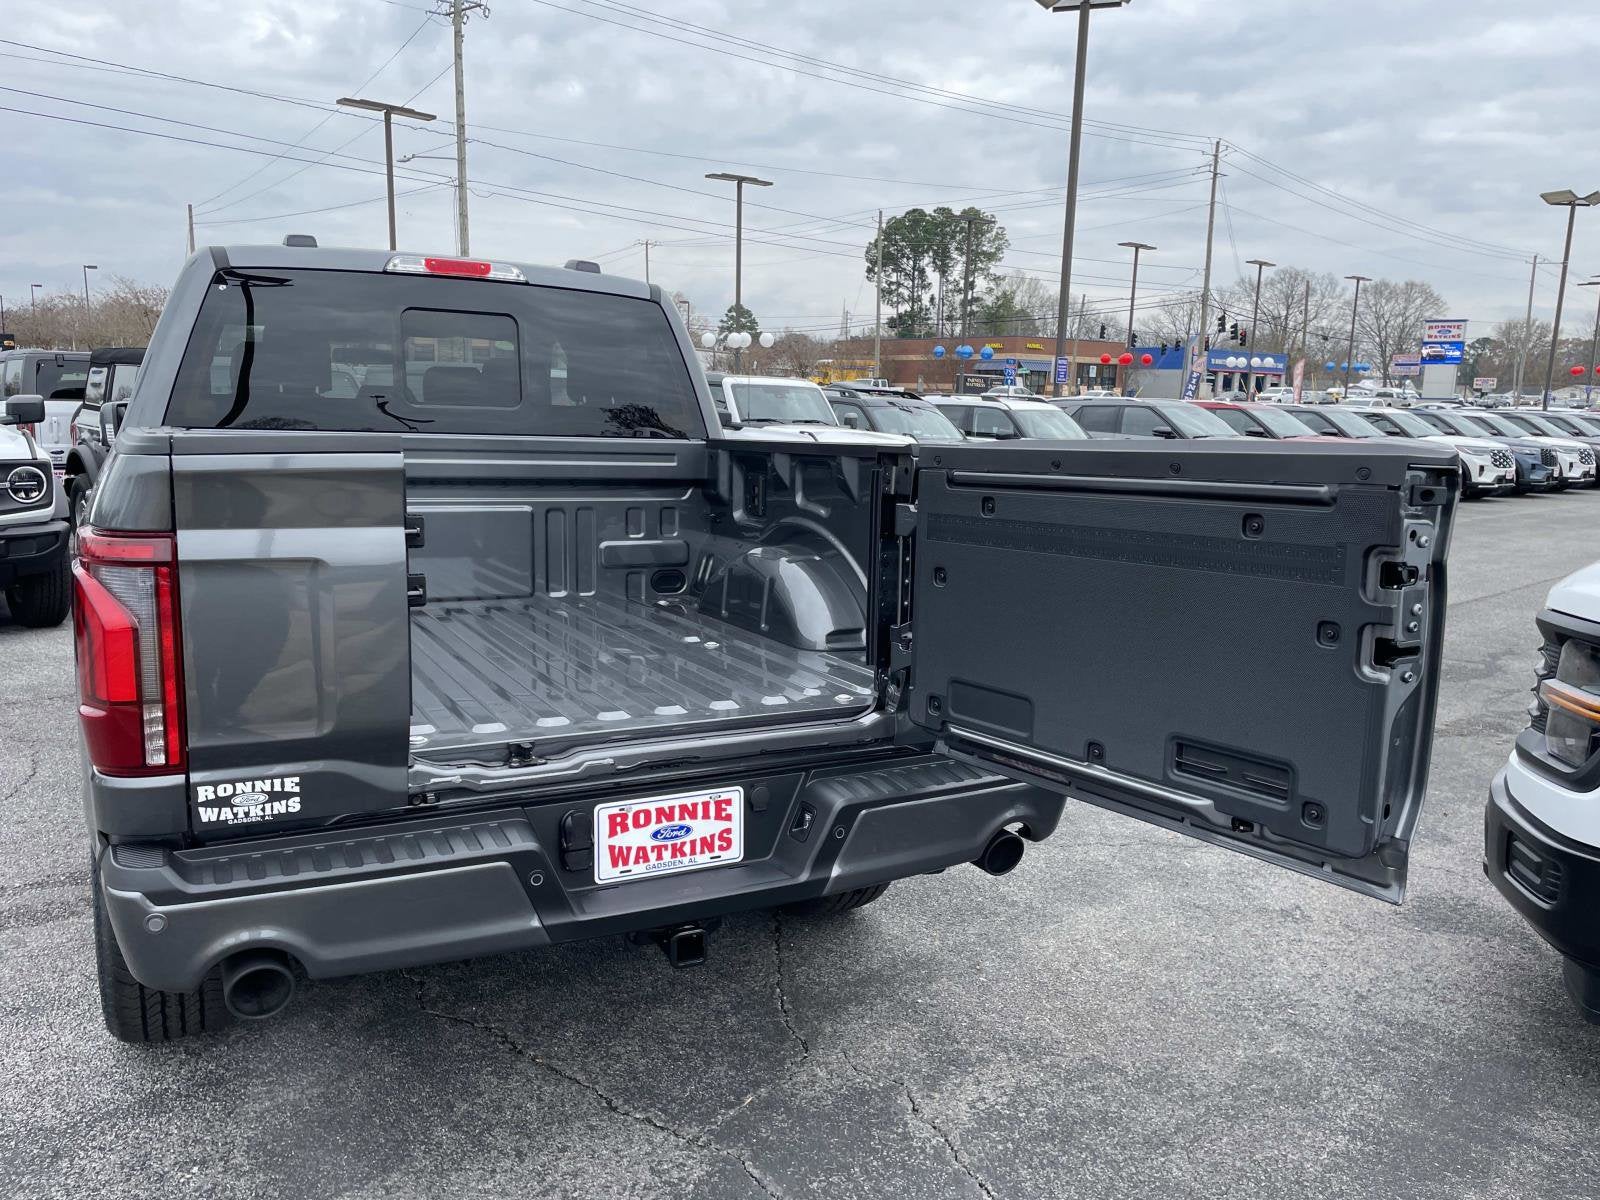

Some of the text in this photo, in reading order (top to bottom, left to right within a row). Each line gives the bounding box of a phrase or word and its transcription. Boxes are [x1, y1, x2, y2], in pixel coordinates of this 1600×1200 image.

[197, 777, 300, 803] RONNIE
[198, 797, 301, 822] WATKINS
[228, 816, 263, 824] GADSDEN,
[608, 798, 733, 839] RONNIE
[608, 827, 733, 869] WATKINS
[688, 857, 699, 865] AL
